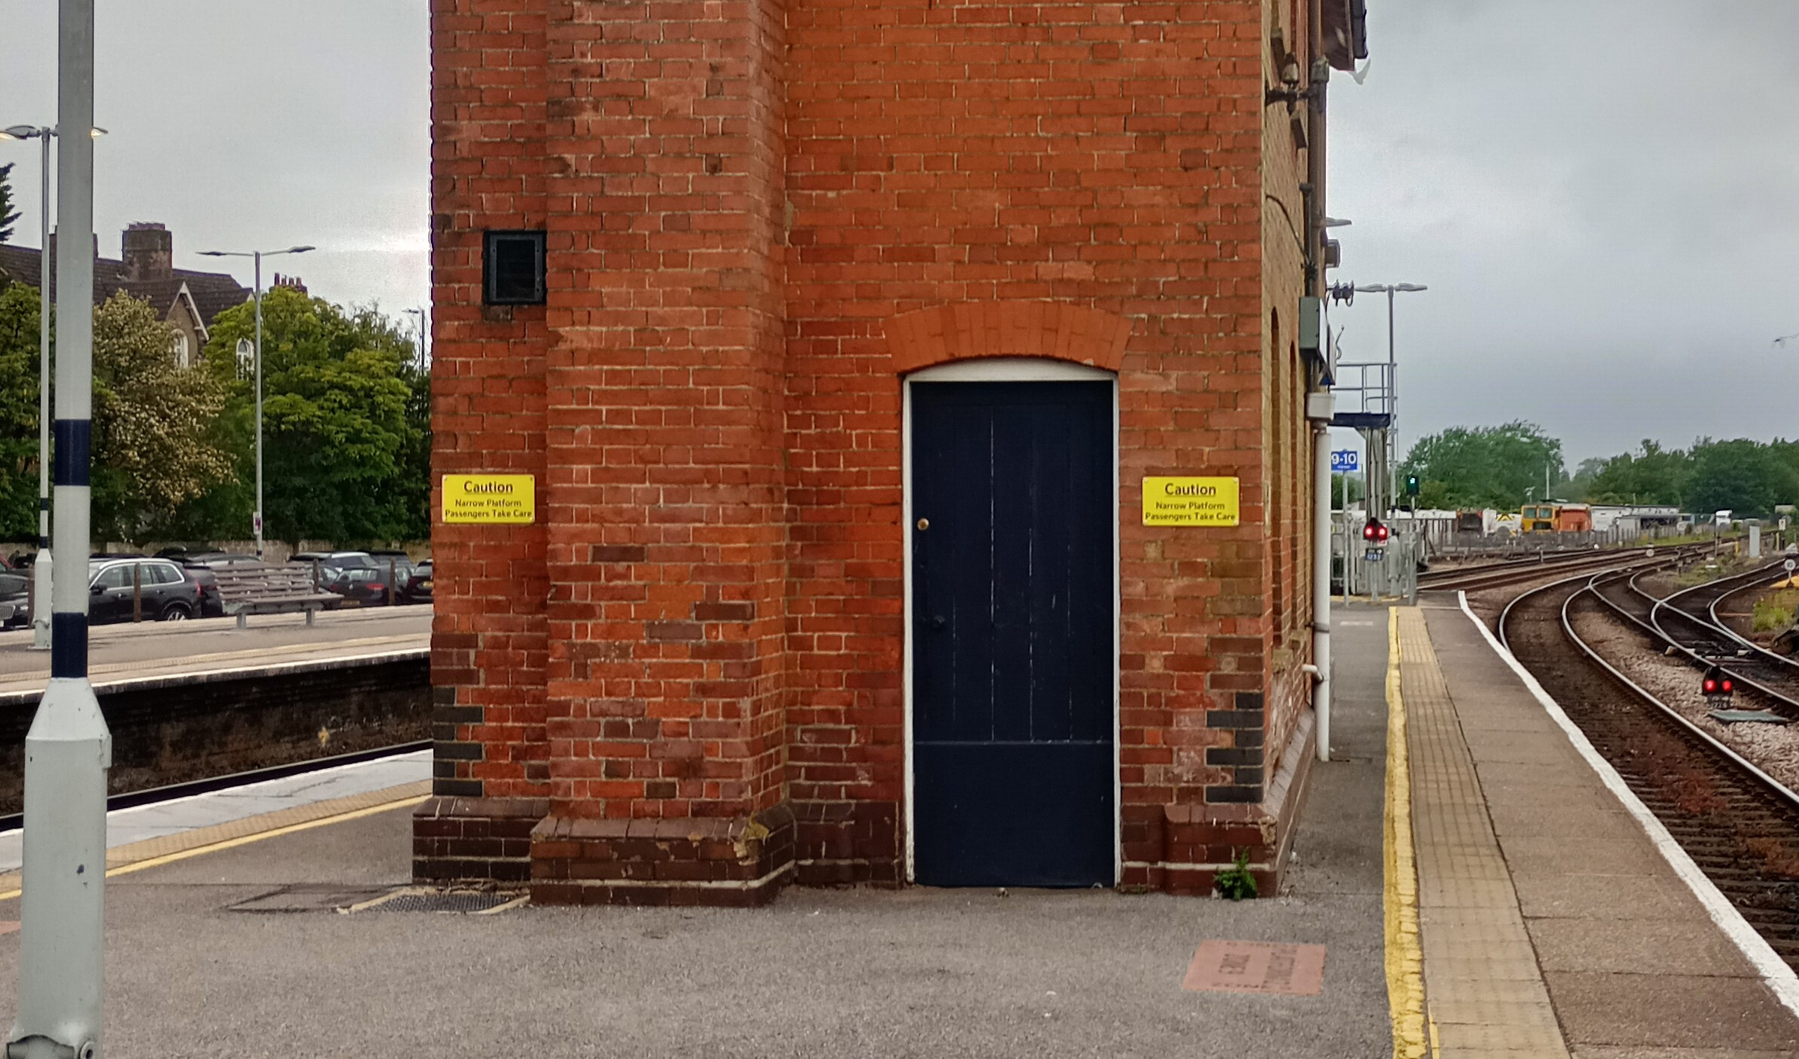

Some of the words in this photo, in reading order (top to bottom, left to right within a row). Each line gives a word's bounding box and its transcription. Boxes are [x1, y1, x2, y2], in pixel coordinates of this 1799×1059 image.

[464, 481, 513, 493] Caution
[1165, 483, 1216, 496] Caution
[455, 499, 485, 507] Narrow
[486, 499, 522, 507] Platform
[1156, 501, 1187, 510] Narrow
[1188, 501, 1225, 510] Platform
[445, 509, 490, 518] Passengers
[492, 509, 511, 517] Take
[513, 509, 532, 517] Care
[1145, 512, 1192, 521] Passengers
[1194, 512, 1214, 520] Take
[1216, 512, 1236, 520] Care
